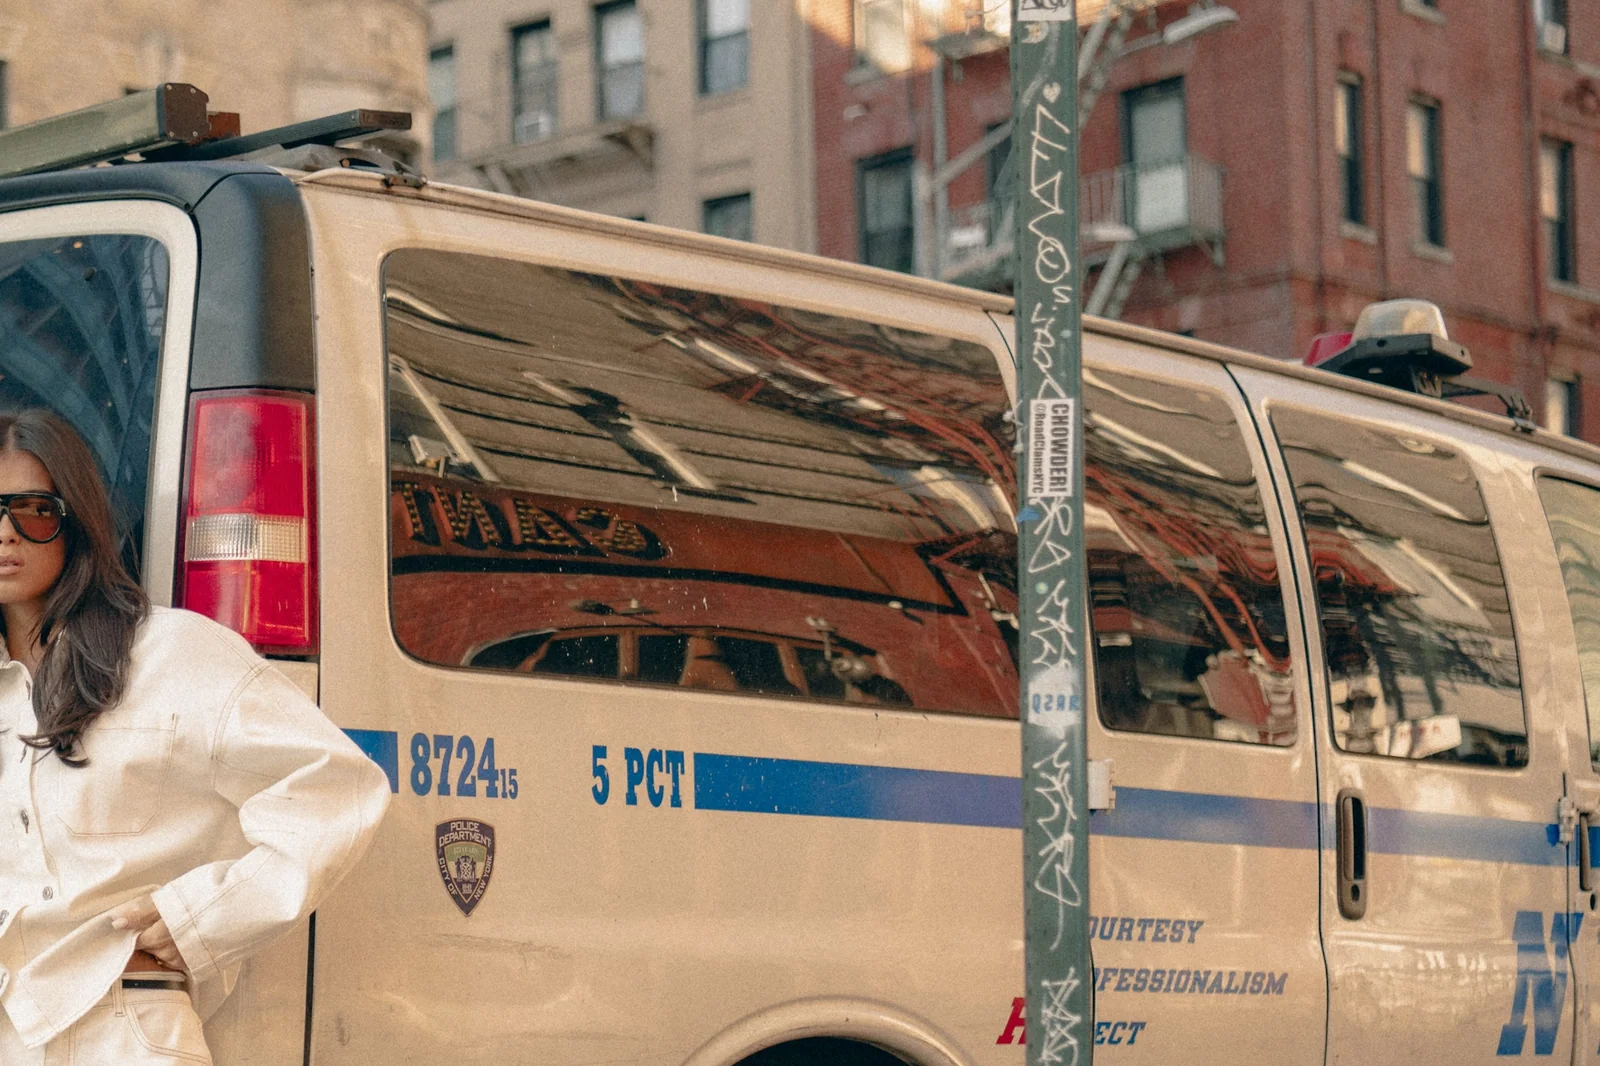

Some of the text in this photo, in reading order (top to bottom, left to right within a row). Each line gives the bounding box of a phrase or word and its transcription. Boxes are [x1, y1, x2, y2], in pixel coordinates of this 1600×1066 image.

[1048, 403, 1070, 493] CHOWDER!
[410, 732, 519, 800] 8724 15
[592, 744, 685, 808] 5 PCT
[439, 830, 492, 848] DEPARTMENT
[450, 821, 480, 832] POLICE
[439, 857, 458, 895] CITY OF
[474, 855, 493, 900] NEW YORK
